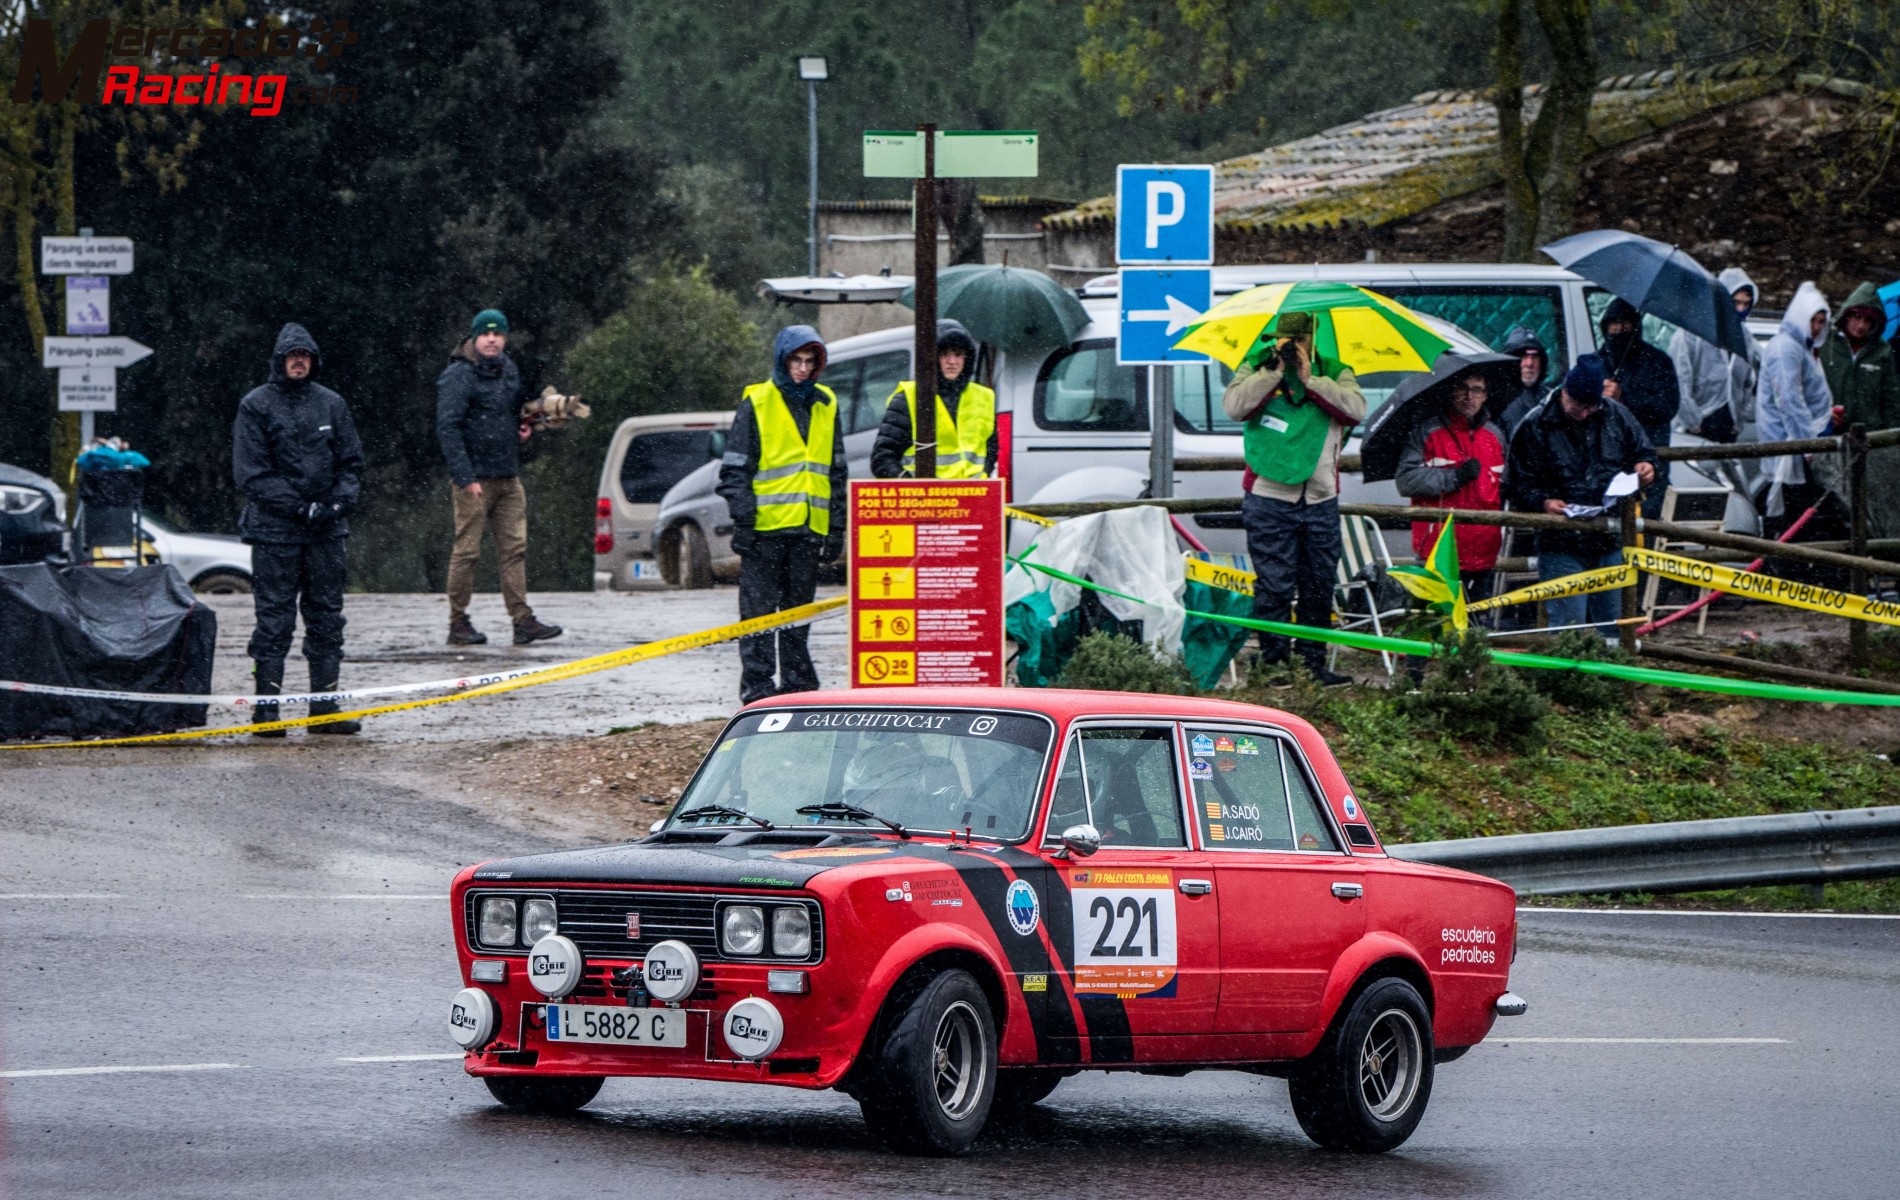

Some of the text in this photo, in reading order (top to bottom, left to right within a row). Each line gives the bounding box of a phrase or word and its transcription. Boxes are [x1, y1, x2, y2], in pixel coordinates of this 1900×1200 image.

[1146, 181, 1185, 248] P
[75, 259, 117, 269] restaurant
[858, 487, 988, 496] PER LA TEVA SEGURETAT
[858, 498, 959, 507] POR TU SEGURIDAD
[858, 509, 970, 518] FOR YOUR OWN SAFETY
[1212, 569, 1250, 595] ZONA
[1524, 583, 1566, 602] ZONA
[1567, 567, 1628, 594] PUBLICO
[1646, 555, 1714, 584] PUBLICO
[1730, 571, 1774, 597] ZONA
[1776, 579, 1848, 610] PUBLICO
[892, 660, 908, 669] 30
[803, 713, 951, 729] GAUCHITOCAT
[1222, 803, 1260, 821] A.SADÓ
[1225, 825, 1263, 842] J.CAIRÓ
[910, 878, 960, 890] GAUCHITOCAT
[1094, 874, 1170, 884] 73 RALLY COSTA BRAVA
[913, 889, 962, 901] GAUCHITOCAT
[1089, 896, 1159, 957] 221
[1441, 926, 1496, 944] escuderia
[1441, 945, 1496, 966] pedralbes
[1025, 975, 1047, 983] SEAT
[551, 1026, 557, 1034] E
[565, 1010, 665, 1041] L 5882 C
